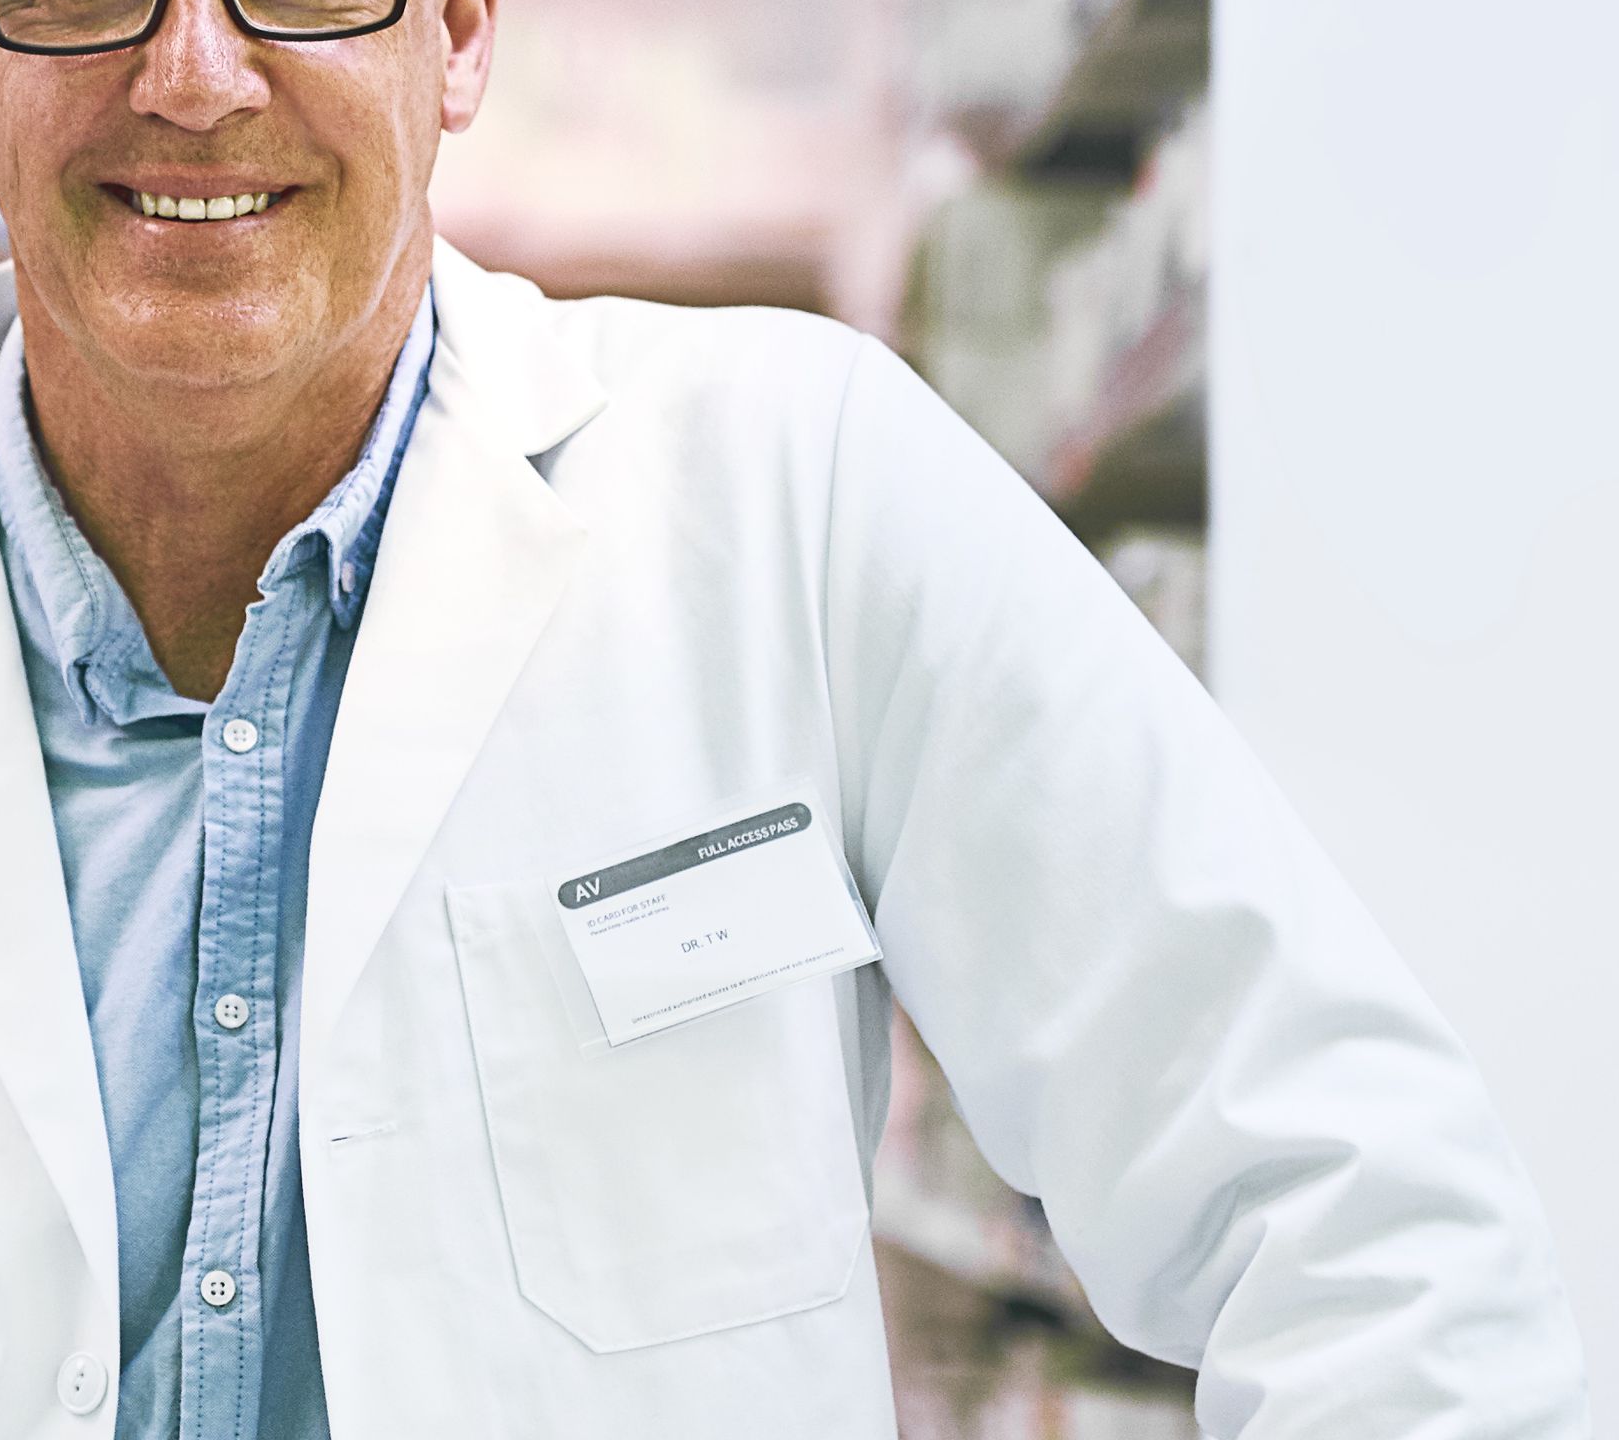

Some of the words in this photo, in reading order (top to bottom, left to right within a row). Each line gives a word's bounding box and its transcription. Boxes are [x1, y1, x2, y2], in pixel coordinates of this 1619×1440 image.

[698, 843, 727, 859] FULL
[727, 827, 769, 850] ACCESS
[768, 816, 799, 836] PASS
[575, 877, 602, 902] AV
[587, 919, 596, 928] ID
[597, 910, 621, 923] CARD
[621, 903, 639, 914] FOR
[639, 894, 666, 909] STAFF
[681, 936, 704, 953] DR.
[705, 933, 714, 945] T
[716, 929, 730, 942] W
[631, 1003, 671, 1024] Unrestricted
[708, 986, 728, 997] access
[780, 964, 790, 972] and
